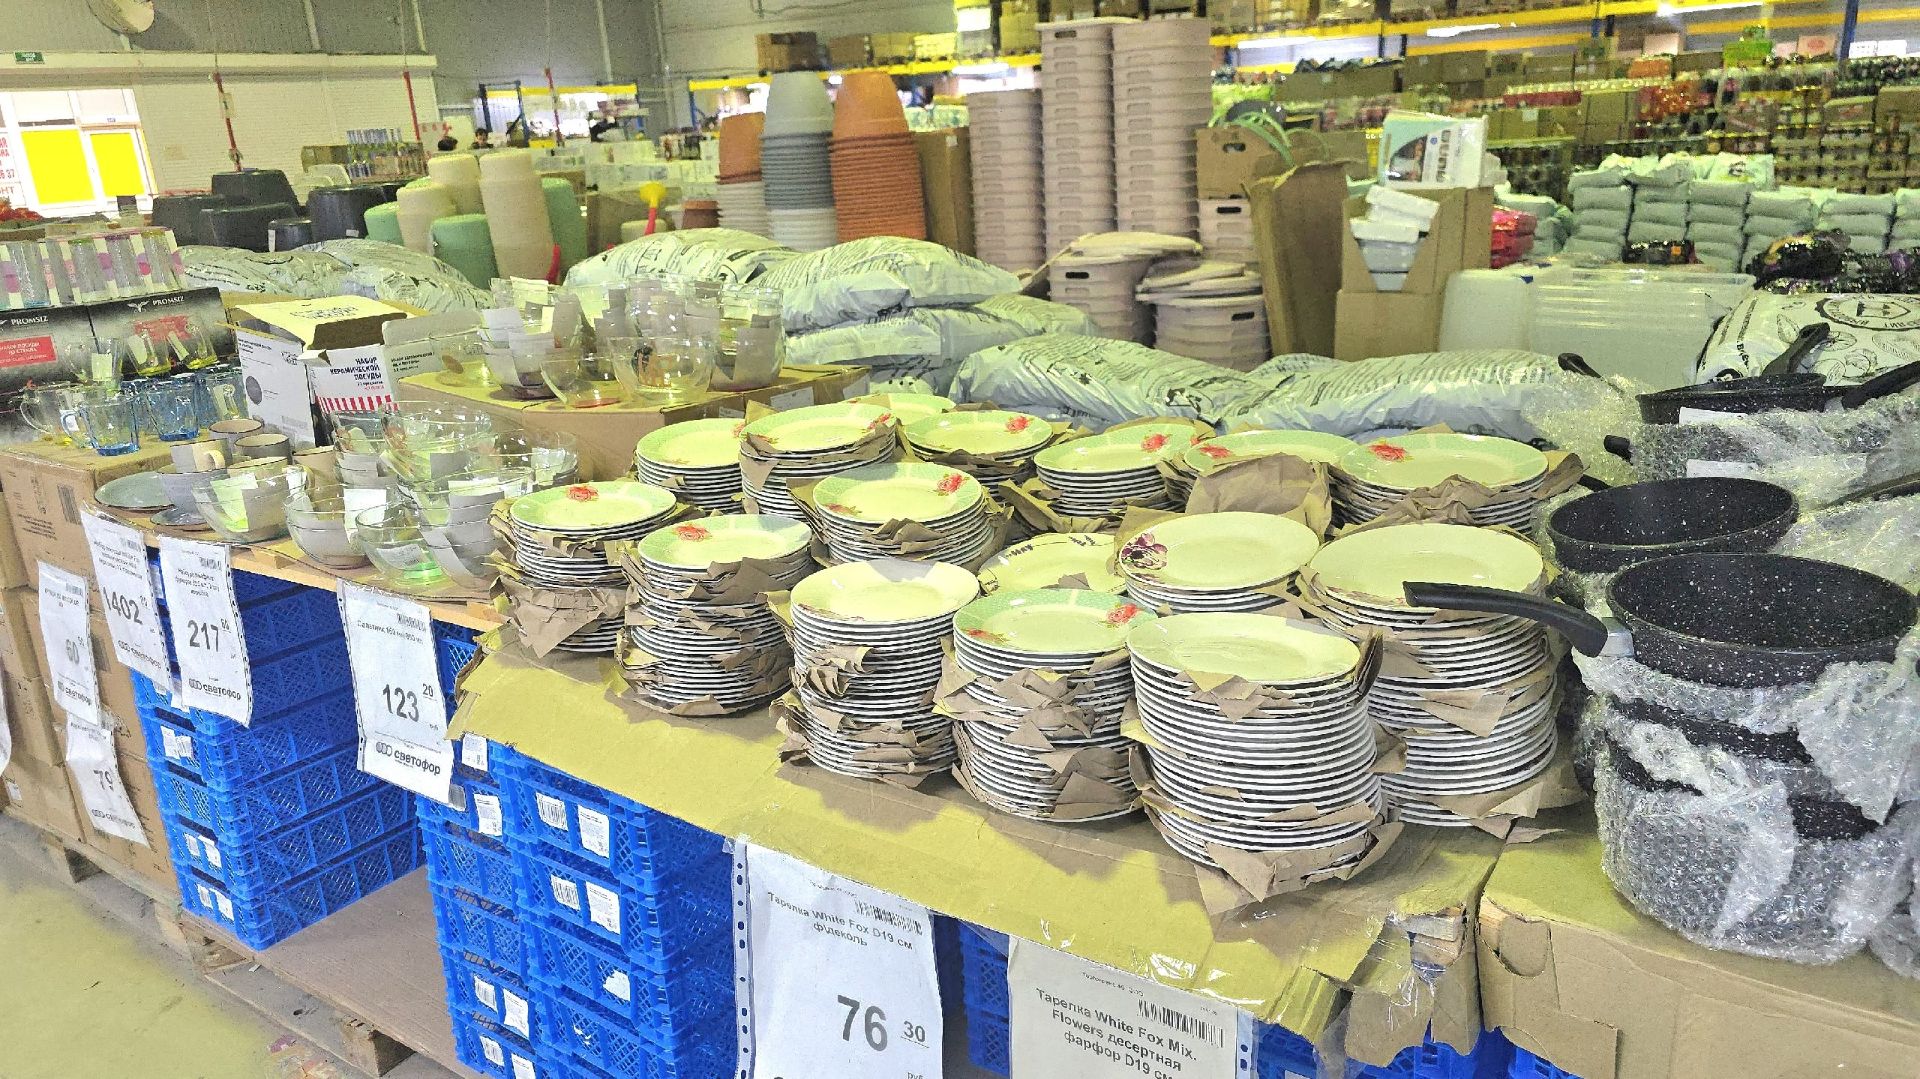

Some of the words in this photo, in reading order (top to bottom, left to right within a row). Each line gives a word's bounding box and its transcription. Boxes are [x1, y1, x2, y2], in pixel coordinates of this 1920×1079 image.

[152, 296, 185, 306] PROMSIZ
[11, 316, 49, 325] PROMSIZ
[354, 373, 382, 381] ПОСУДЫ
[355, 357, 377, 366] НАБОР
[103, 587, 143, 625] 1402
[187, 620, 219, 652] 217
[203, 684, 241, 701] светофор
[382, 684, 420, 722] 123
[422, 683, 434, 698] 20
[394, 750, 441, 776] светофор
[93, 769, 114, 791] 79
[768, 892, 809, 917] Тарелка
[812, 910, 846, 926] White
[849, 919, 870, 935] Fox
[873, 928, 894, 943] D19
[897, 938, 914, 951] см
[838, 994, 888, 1052] 76
[903, 1020, 927, 1043] 30
[1036, 988, 1092, 1018] Тарелка
[1095, 1009, 1134, 1035] White
[1138, 1027, 1164, 1047] Fox
[1168, 1039, 1198, 1061] Mix.
[1052, 1009, 1104, 1039] Flowers
[1107, 1032, 1182, 1072] десертная
[1064, 1031, 1121, 1062] фарфор
[1125, 1055, 1151, 1075] D19
